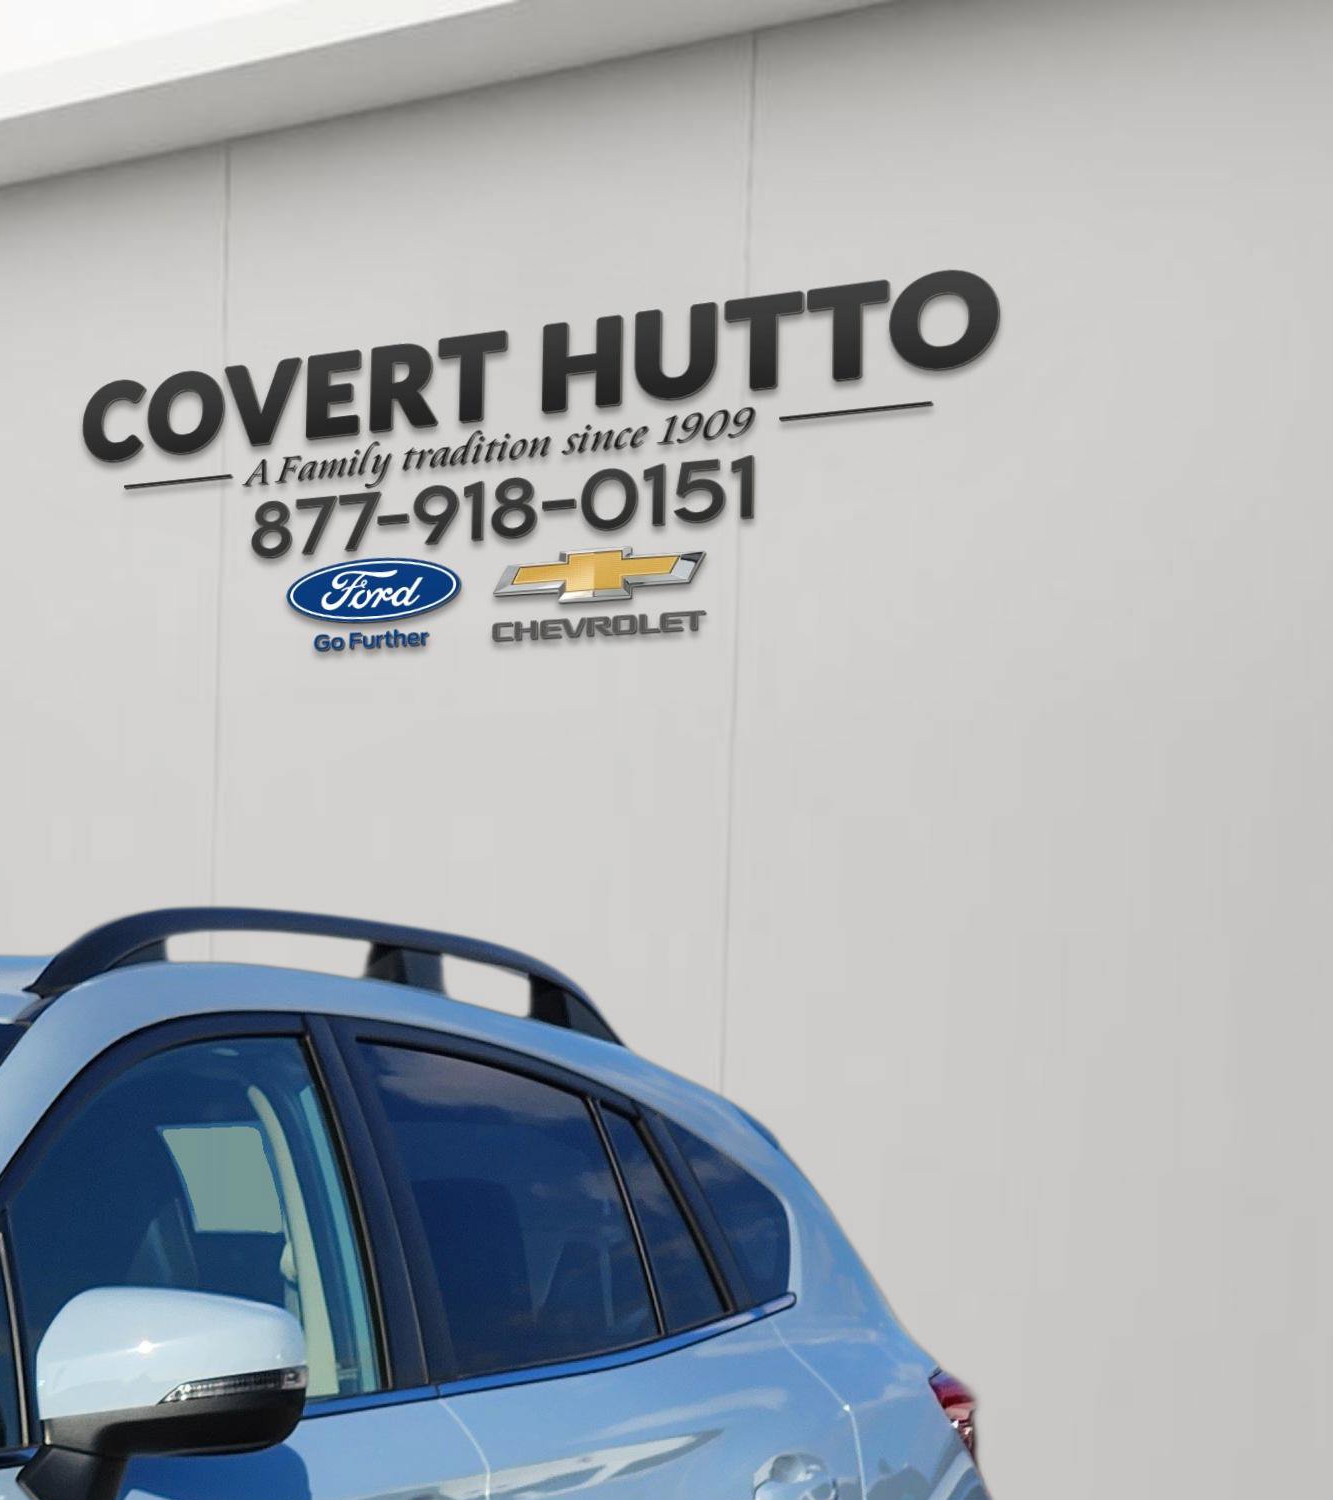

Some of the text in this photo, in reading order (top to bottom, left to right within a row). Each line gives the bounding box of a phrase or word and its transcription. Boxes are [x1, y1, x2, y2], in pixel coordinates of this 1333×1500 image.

[81, 270, 1000, 463] COVERT HUTTO
[242, 406, 757, 489] A Family tradition since 1909
[251, 454, 755, 559] 877-918-0151
[320, 569, 422, 611] Ford
[313, 628, 430, 653] Go Further
[491, 610, 707, 644] CHEVROLET
